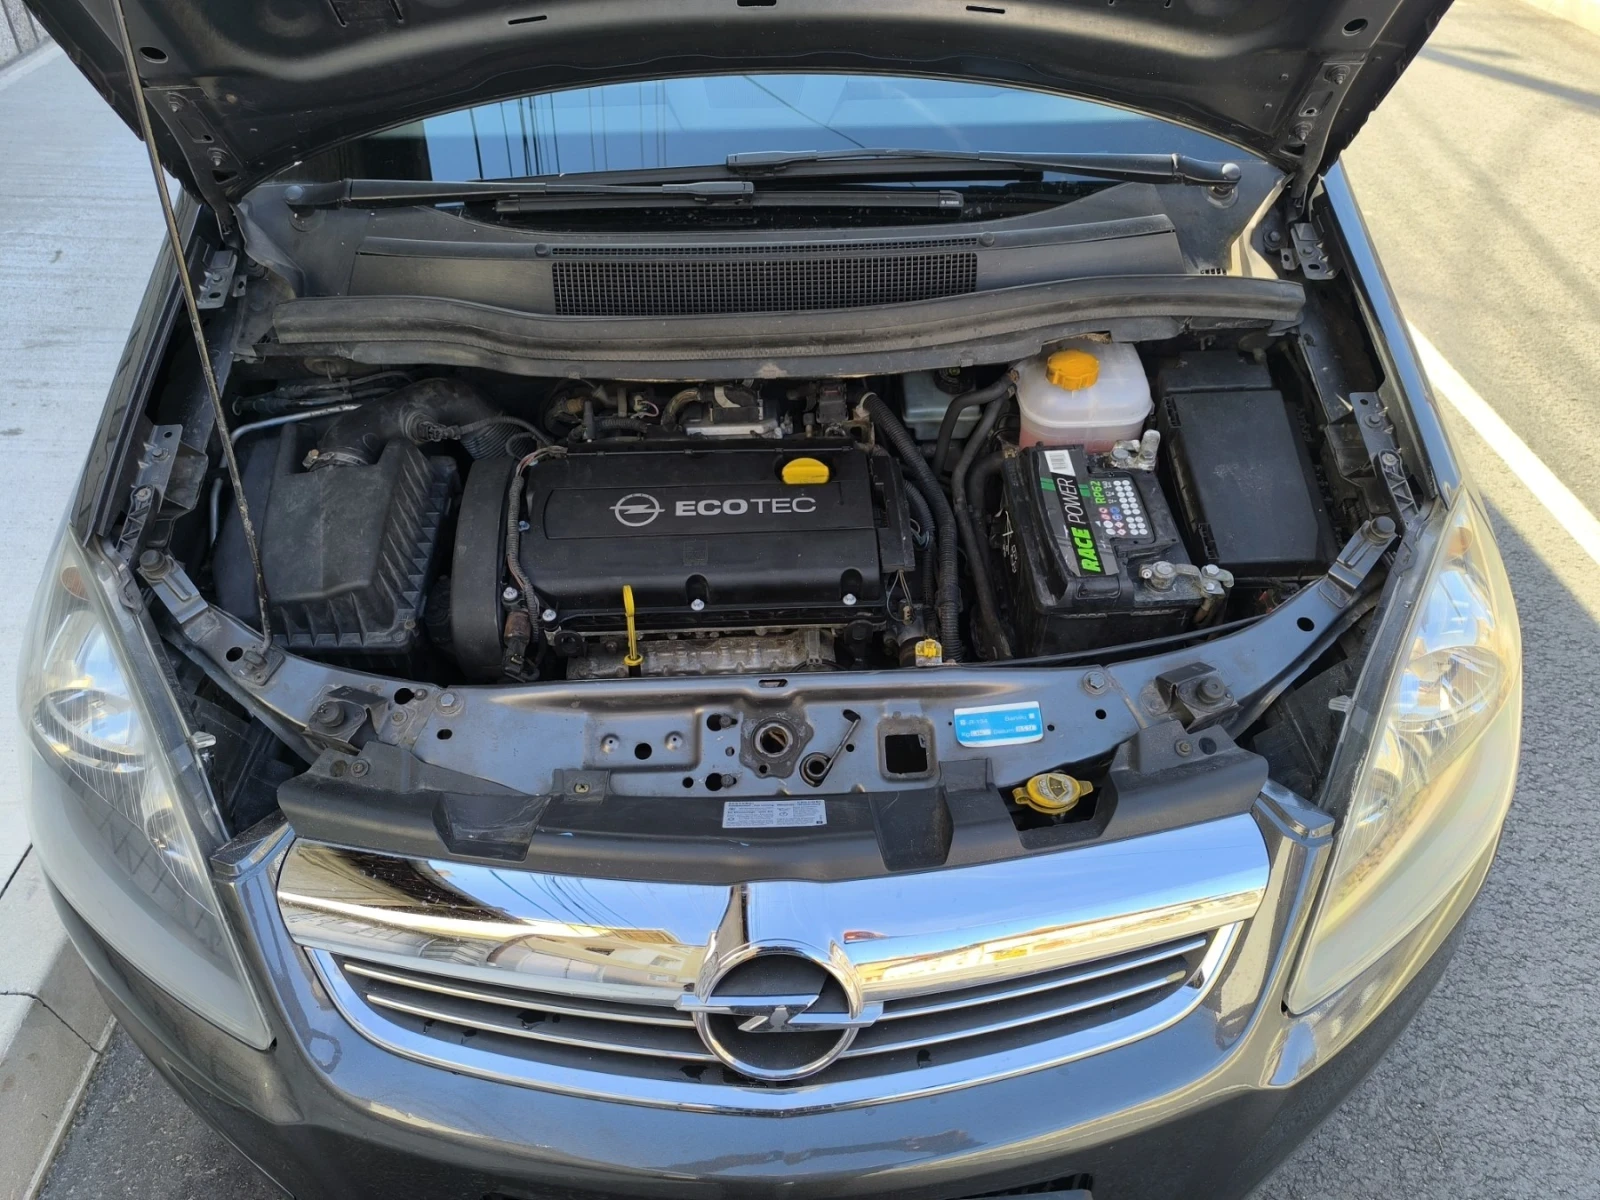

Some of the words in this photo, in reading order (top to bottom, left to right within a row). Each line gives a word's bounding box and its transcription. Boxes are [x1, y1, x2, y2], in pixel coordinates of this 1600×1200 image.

[675, 497, 817, 516] ECOTEC
[1056, 477, 1086, 524] POWER
[1090, 480, 1106, 504] RP62
[1071, 526, 1101, 572] RACE
